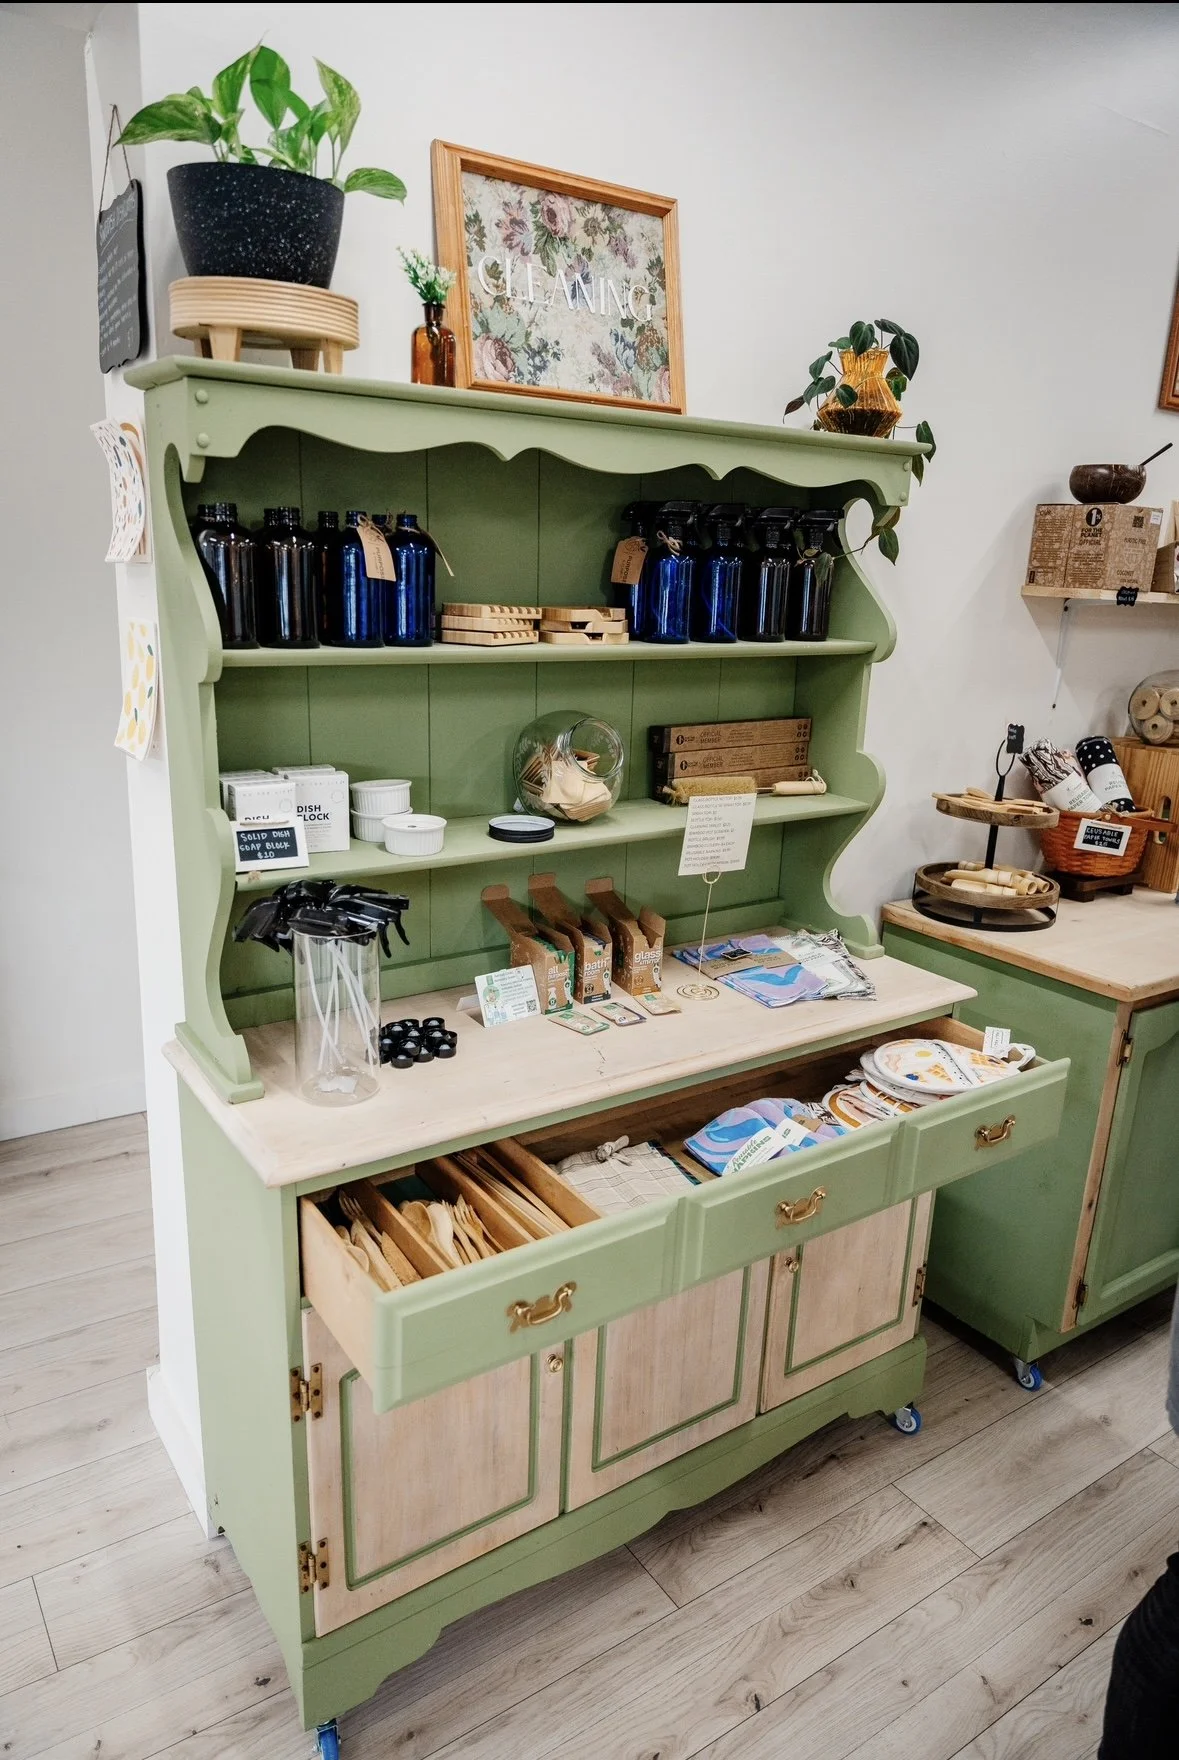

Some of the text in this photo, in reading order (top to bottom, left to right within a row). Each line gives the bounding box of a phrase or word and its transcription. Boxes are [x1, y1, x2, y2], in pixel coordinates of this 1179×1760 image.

[477, 255, 656, 322] CLEANING
[297, 805, 321, 813] DISH
[297, 813, 330, 821] LOCK
[240, 830, 291, 842] SOLID DISH
[1086, 827, 1119, 837] REUSABLE
[239, 841, 290, 851] SOAP BLOCK
[257, 851, 275, 859] $10
[634, 950, 661, 963] glass
[547, 965, 559, 975] all
[584, 959, 607, 971] bath
